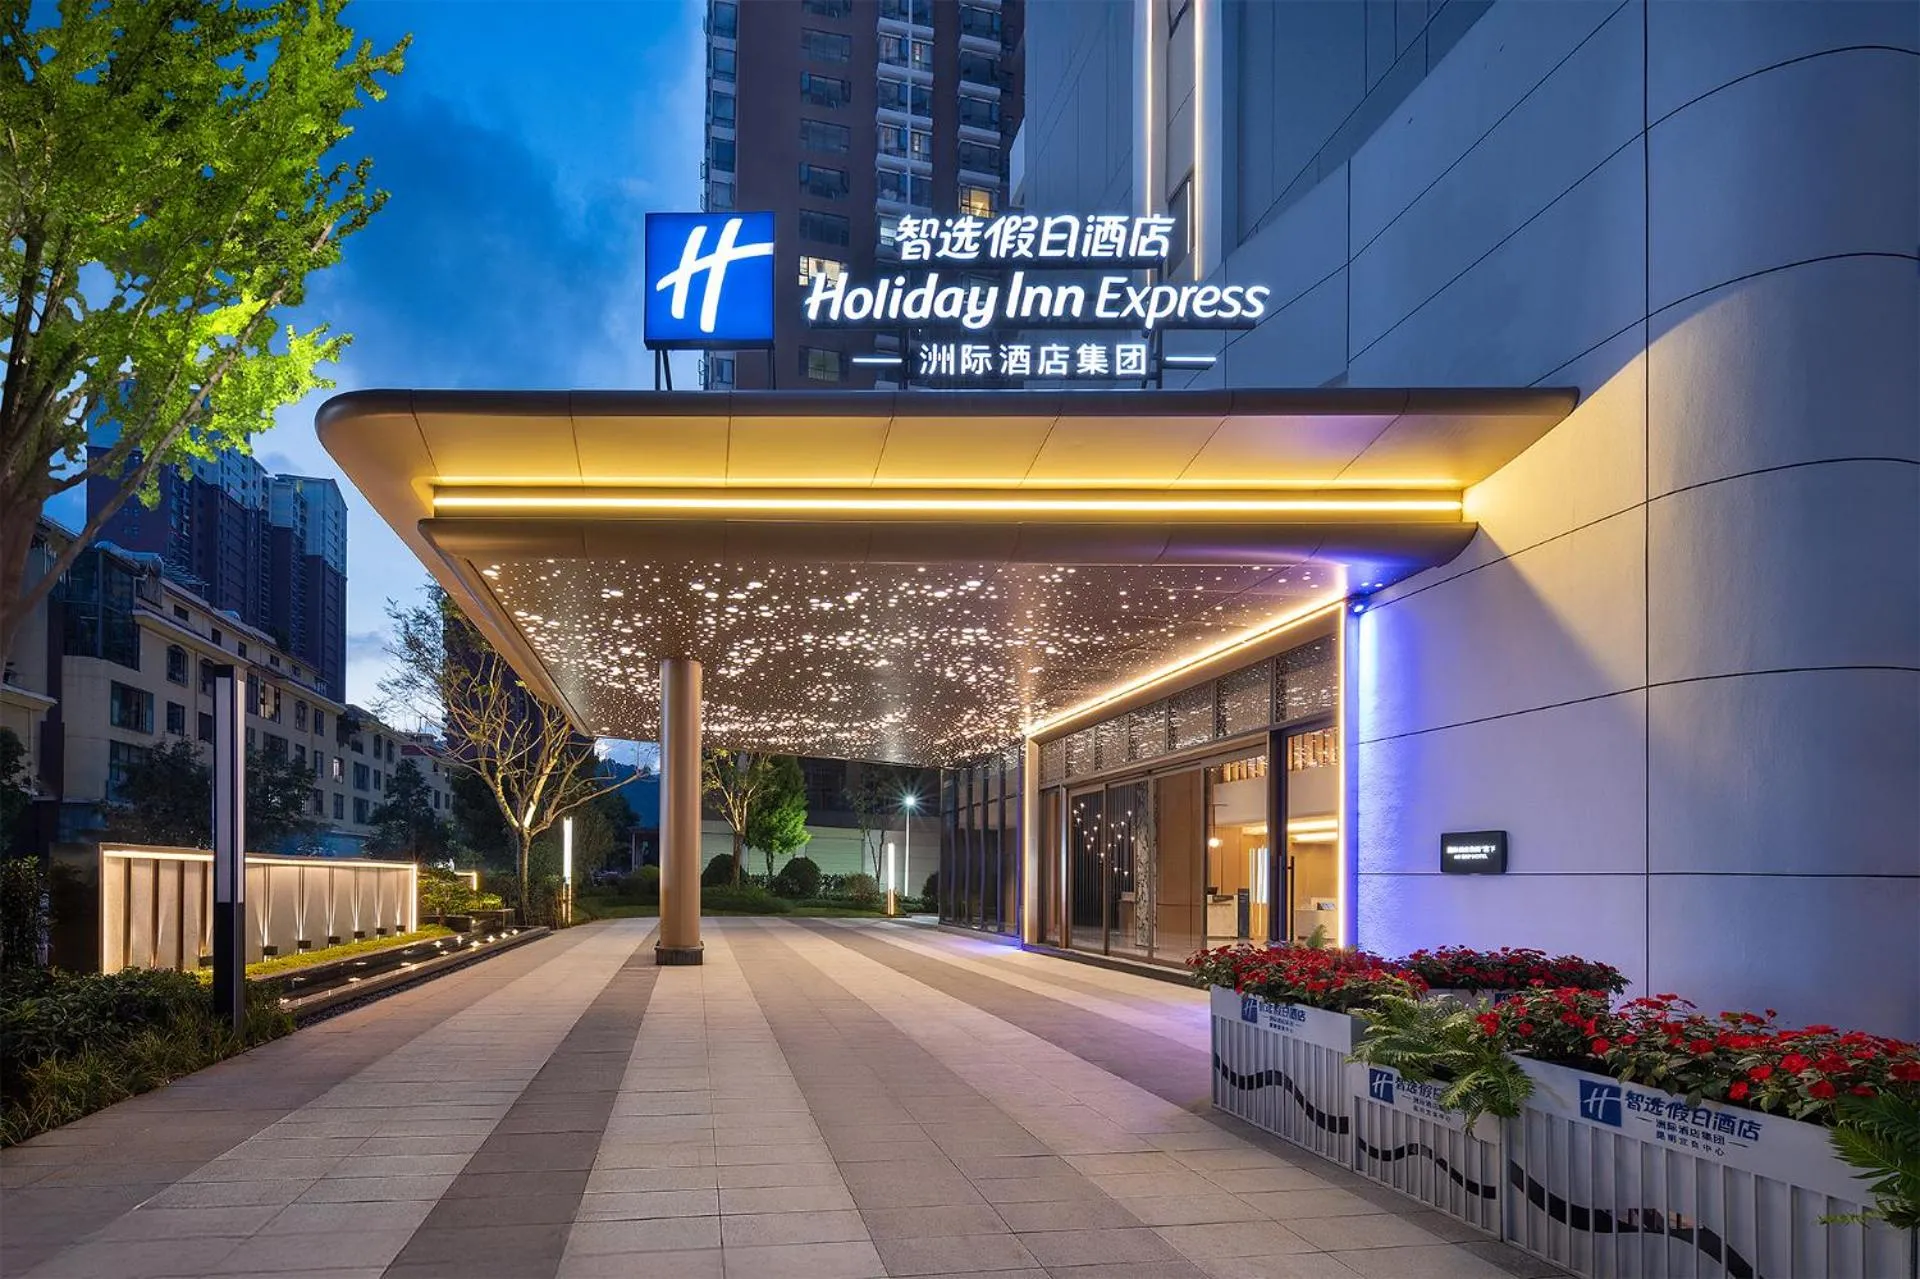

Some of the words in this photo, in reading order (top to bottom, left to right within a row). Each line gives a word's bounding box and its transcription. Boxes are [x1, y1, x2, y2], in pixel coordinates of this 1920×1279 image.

[895, 214, 1175, 260] 智选假日酒店
[805, 272, 998, 329] Holiday
[1006, 271, 1085, 319] Inn
[1095, 276, 1271, 329] Express
[920, 343, 1147, 376] 洲际酒店集团
[1625, 1090, 1762, 1141] 智选假日酒店
